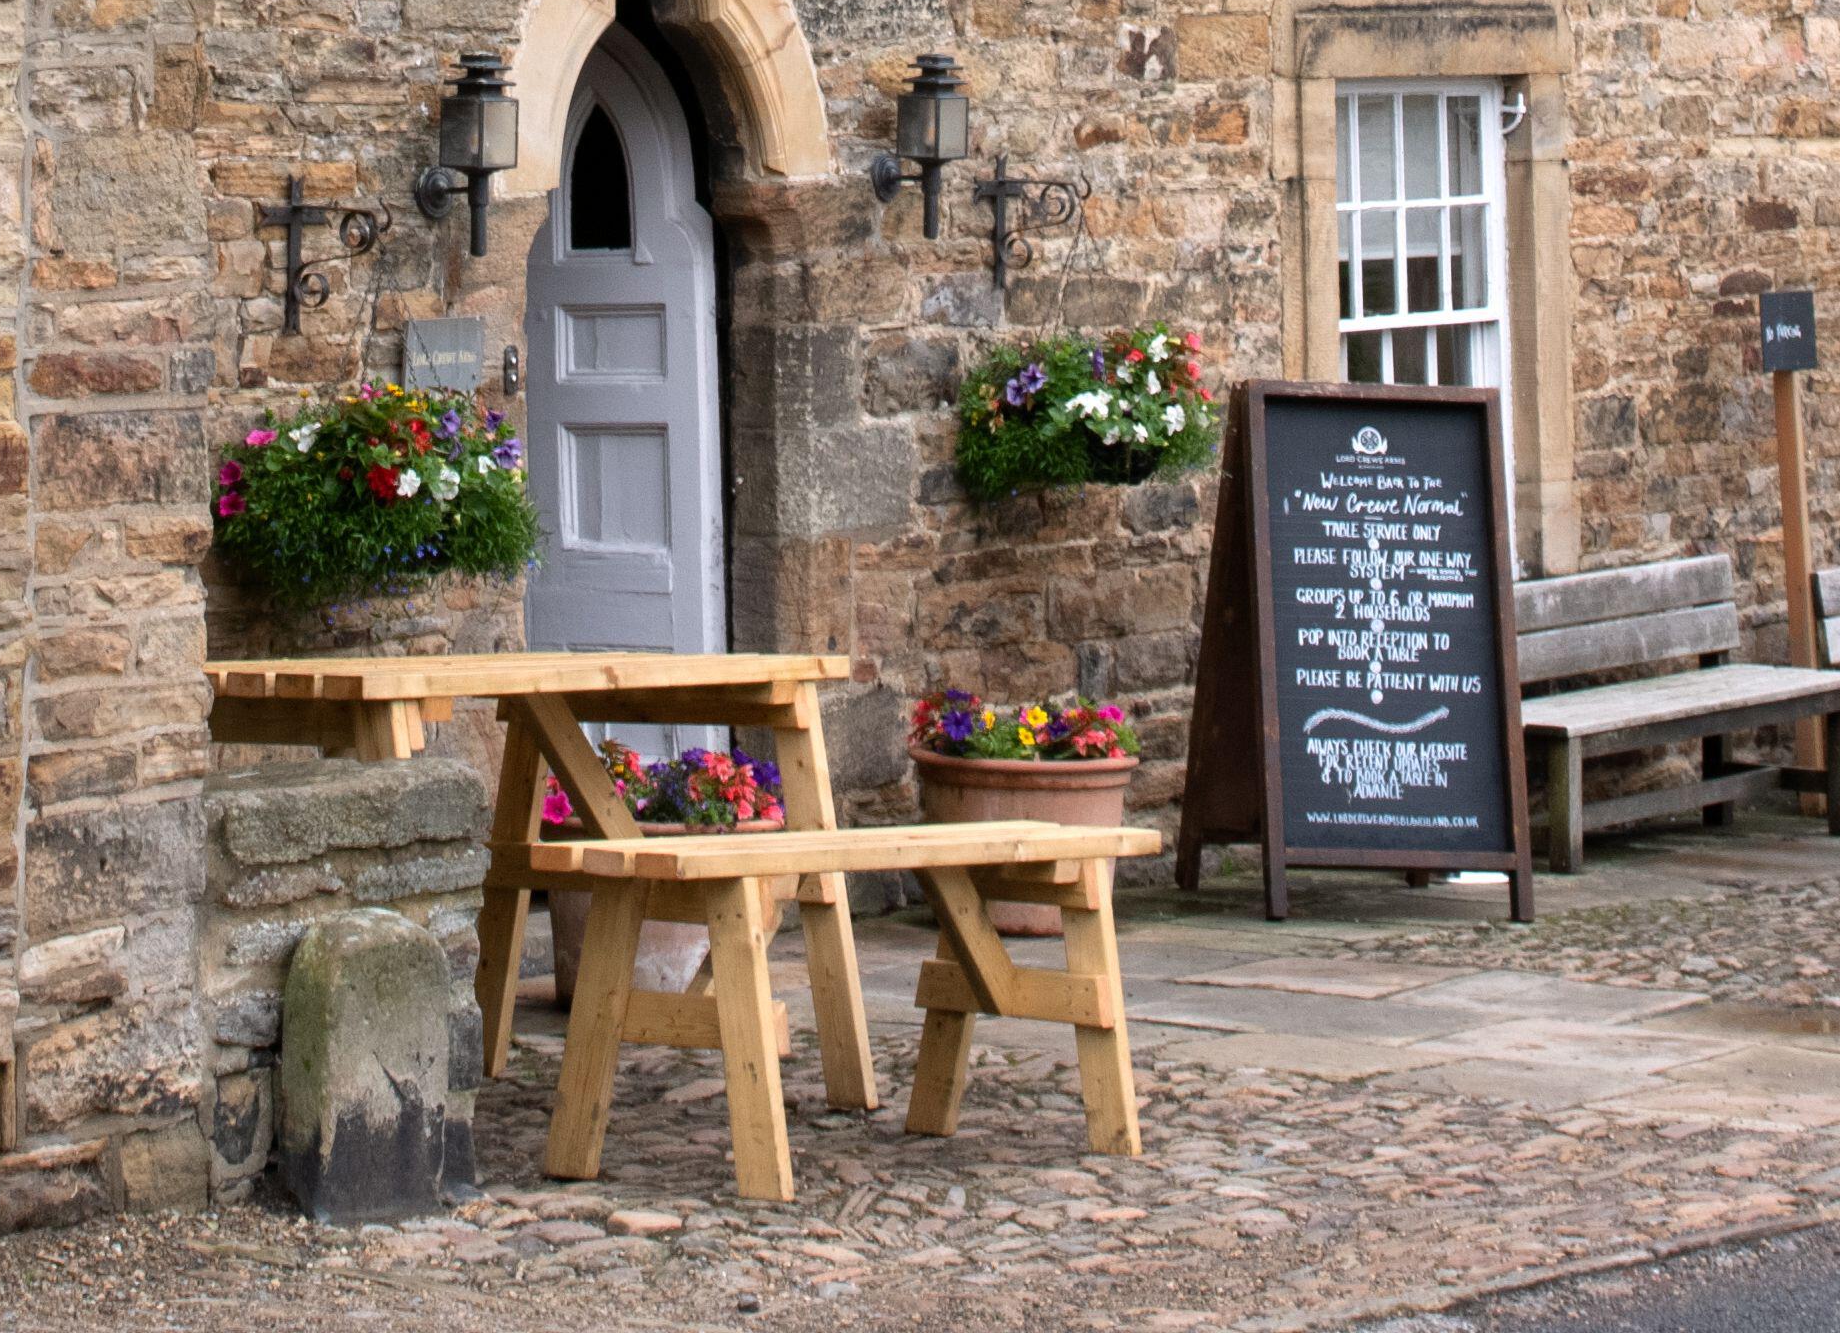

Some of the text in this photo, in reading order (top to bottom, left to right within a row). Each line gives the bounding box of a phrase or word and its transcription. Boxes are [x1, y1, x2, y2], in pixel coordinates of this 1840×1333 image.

[1346, 492, 1400, 514] Crewe
[1322, 520, 1442, 542] TABLE SERVICE ONLY
[1294, 547, 1472, 569] PLEASE FOLLOW OUR ONE WAY
[1349, 564, 1405, 580] SYSTEM
[1296, 587, 1474, 608] GROUPS UP TO 6 OR MAXIMUM
[1335, 603, 1431, 622] 2 HOUSEHOLDS
[1298, 628, 1450, 651] POP INTO RECEPTION TO
[1338, 645, 1420, 663] BOOK A TABLE
[1296, 668, 1481, 694] PLEASE BE PATIENT WITH US
[1307, 738, 1468, 761] ALWAYS CHECK OUR WEBSITE
[1318, 753, 1440, 773] FOR RECENT UPDATES
[1337, 769, 1352, 784] TO
[1356, 769, 1386, 785] BOOK
[1389, 770, 1399, 785] A
[1400, 771, 1432, 787] TABLE
[1435, 772, 1447, 788] IN
[1353, 782, 1404, 800] ADVANCE
